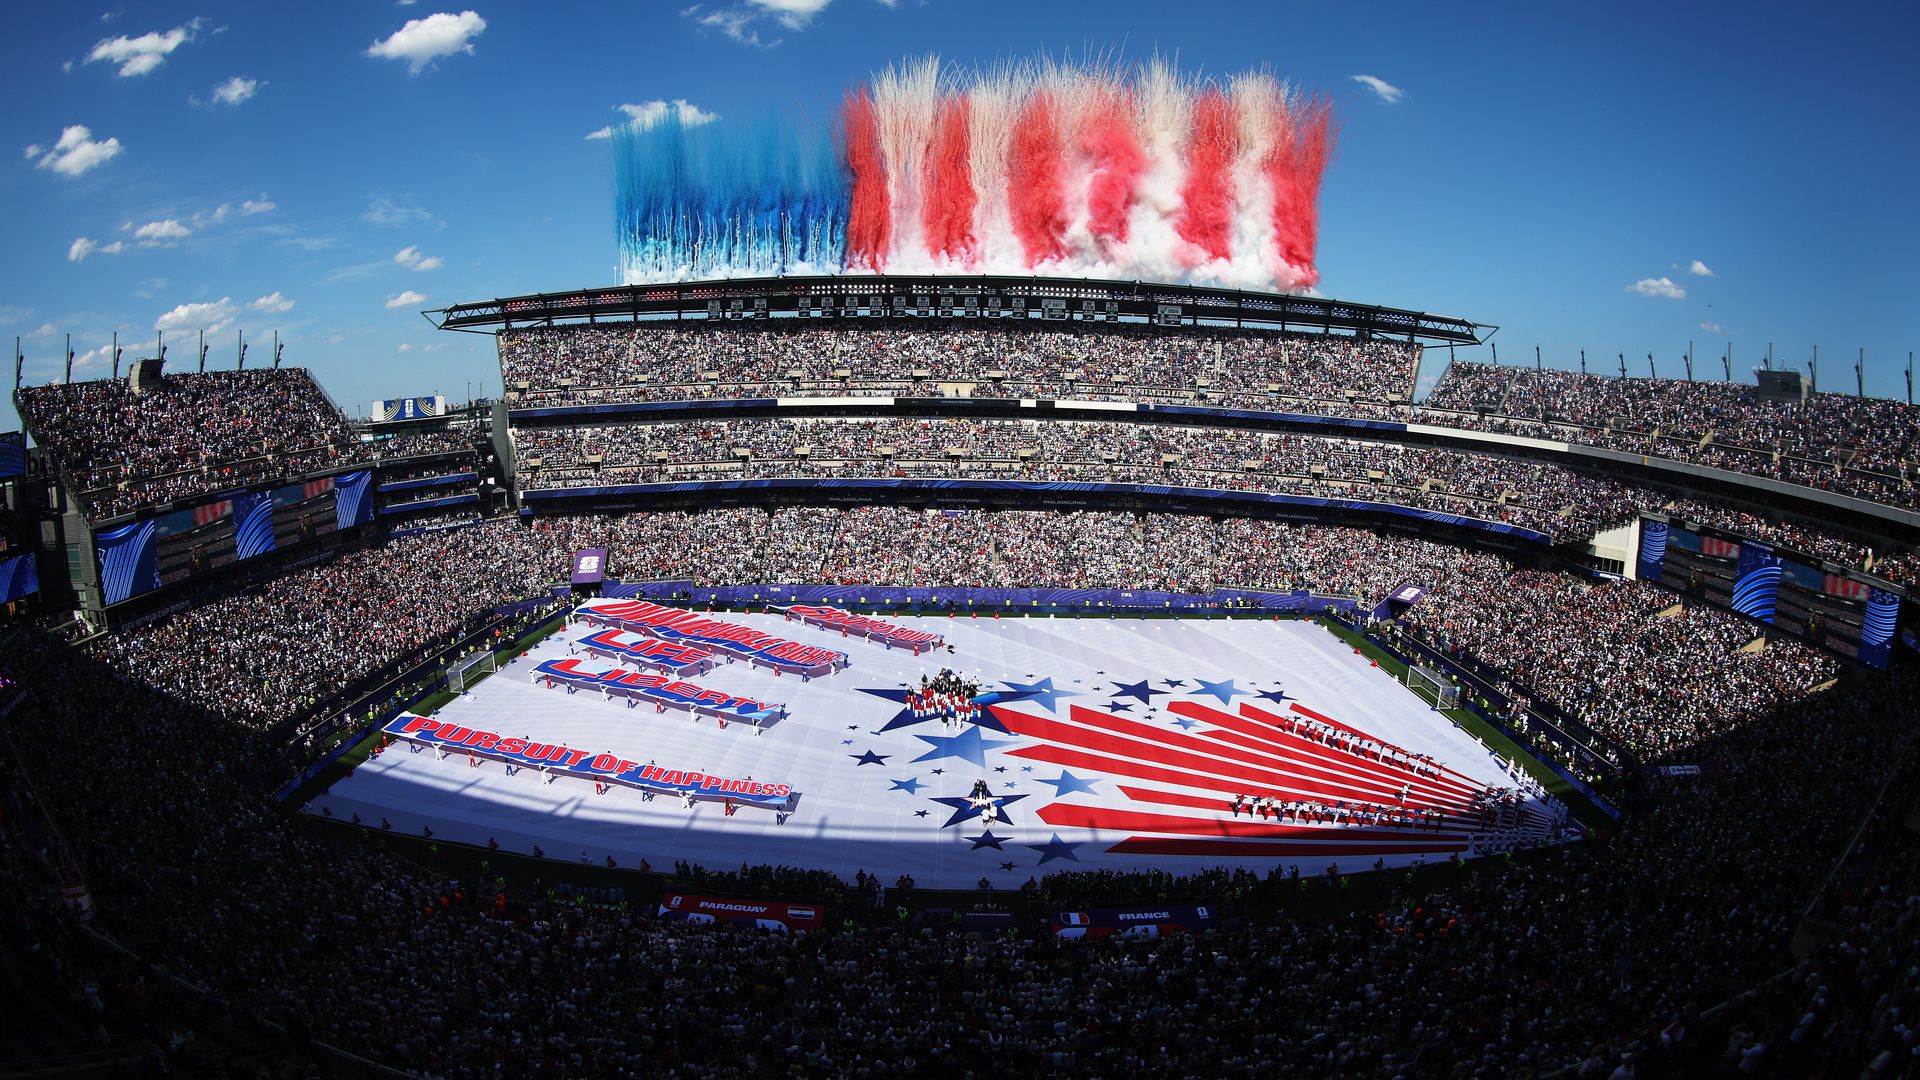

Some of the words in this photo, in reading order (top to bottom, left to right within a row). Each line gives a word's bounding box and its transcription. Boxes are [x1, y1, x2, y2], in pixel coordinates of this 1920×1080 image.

[425, 519, 474, 531] PHILADELPHIA
[591, 629, 714, 664] LIFE
[765, 641, 843, 666] RIGHTS
[548, 658, 779, 711] LIBERTY
[401, 716, 590, 767] PURSUIT
[589, 752, 640, 774] OF
[640, 765, 791, 797] HAPPINESS
[699, 901, 769, 913] PARAGUAY
[1118, 911, 1171, 921] FRANCE
